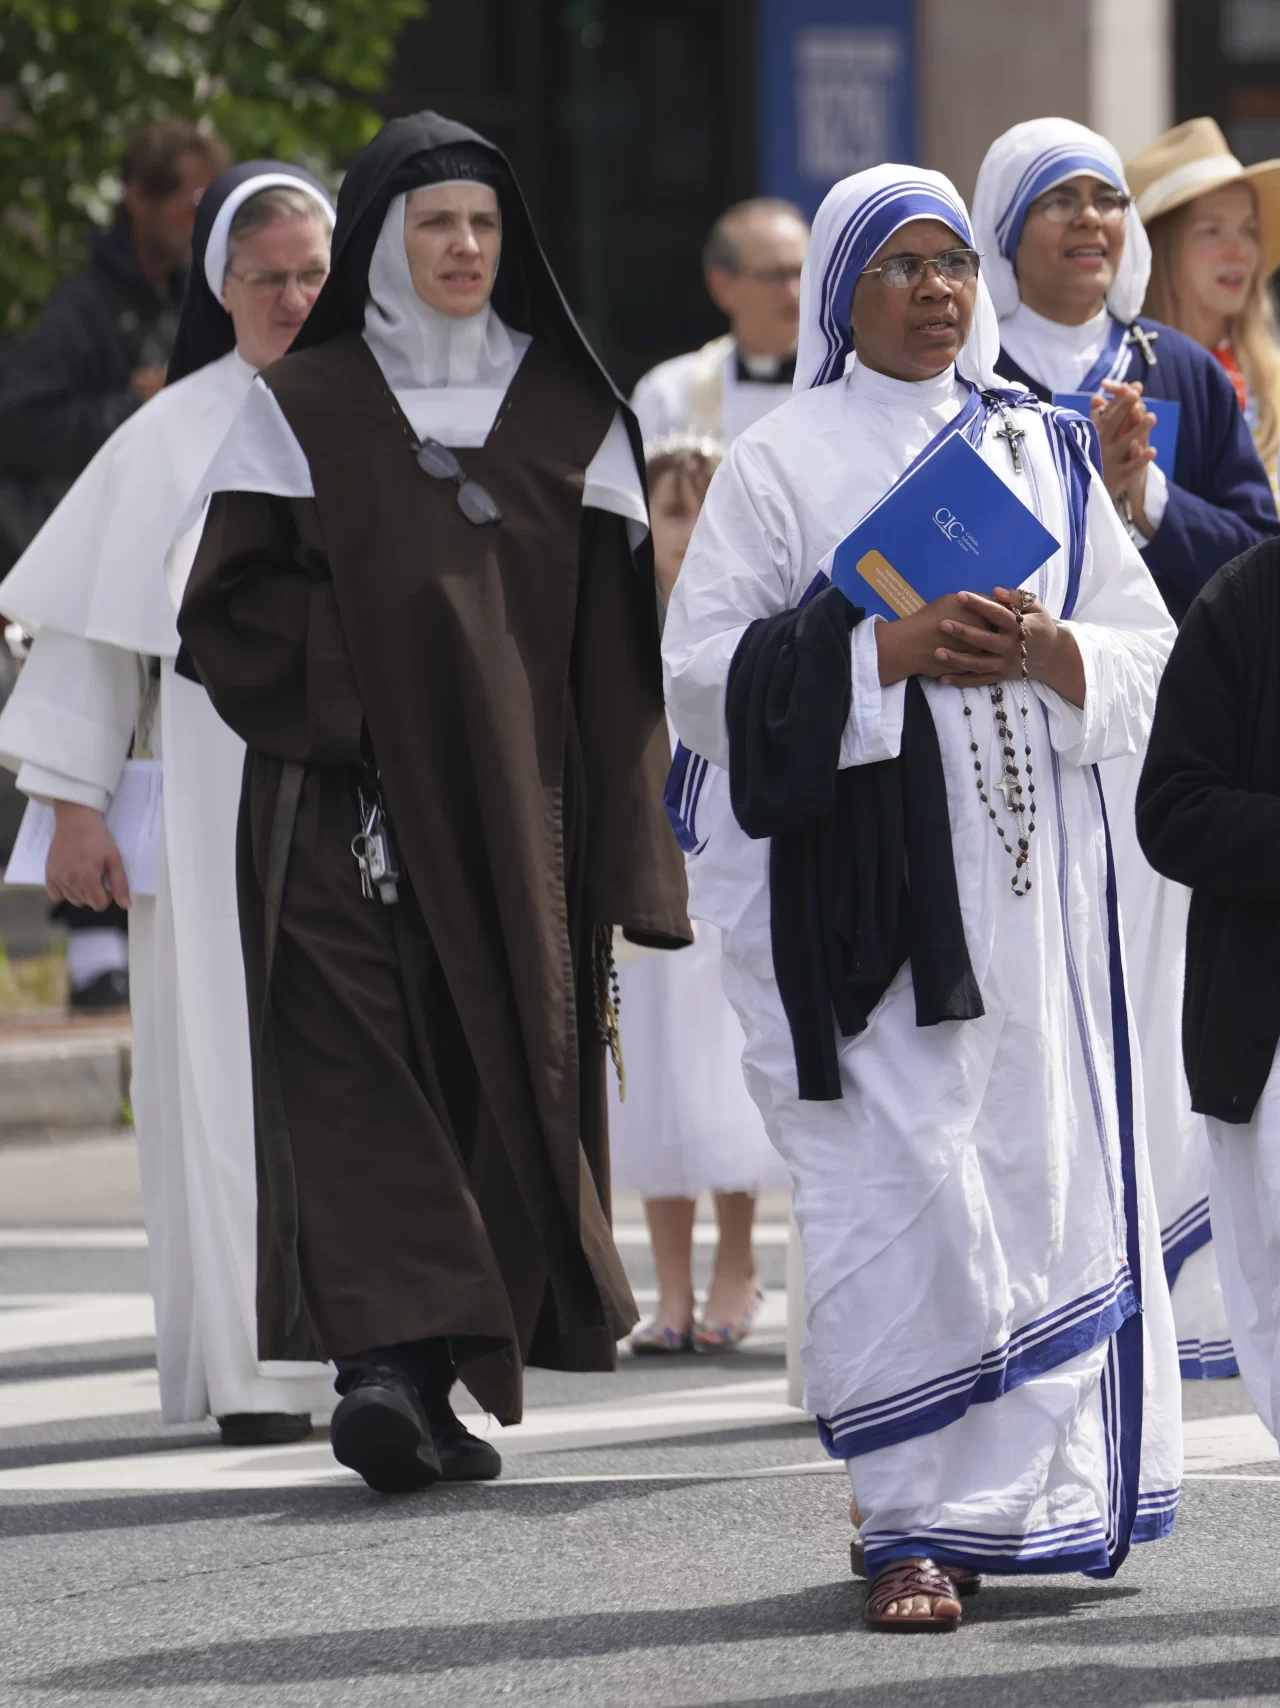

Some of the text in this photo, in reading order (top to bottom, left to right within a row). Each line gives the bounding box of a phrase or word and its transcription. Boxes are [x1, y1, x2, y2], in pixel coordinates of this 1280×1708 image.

[935, 508, 964, 538] CIC
[961, 535, 979, 555] Information
[900, 595, 917, 613] Washing
